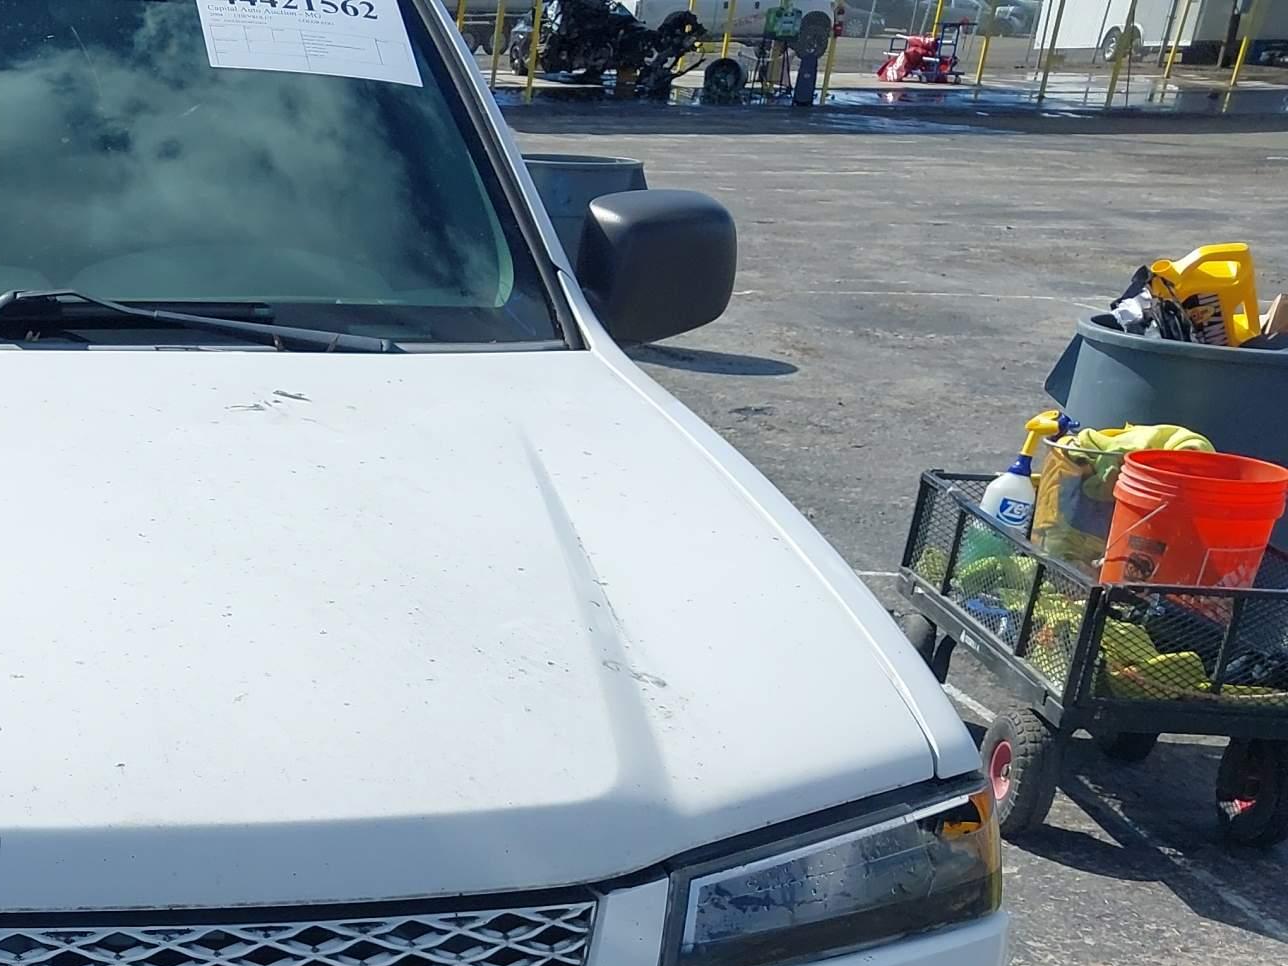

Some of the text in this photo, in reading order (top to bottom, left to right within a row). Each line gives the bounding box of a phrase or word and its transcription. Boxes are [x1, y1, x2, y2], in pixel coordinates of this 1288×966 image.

[207, 4, 238, 13] Capital
[264, 8, 297, 16] Auction
[228, 0, 378, 19] 21562
